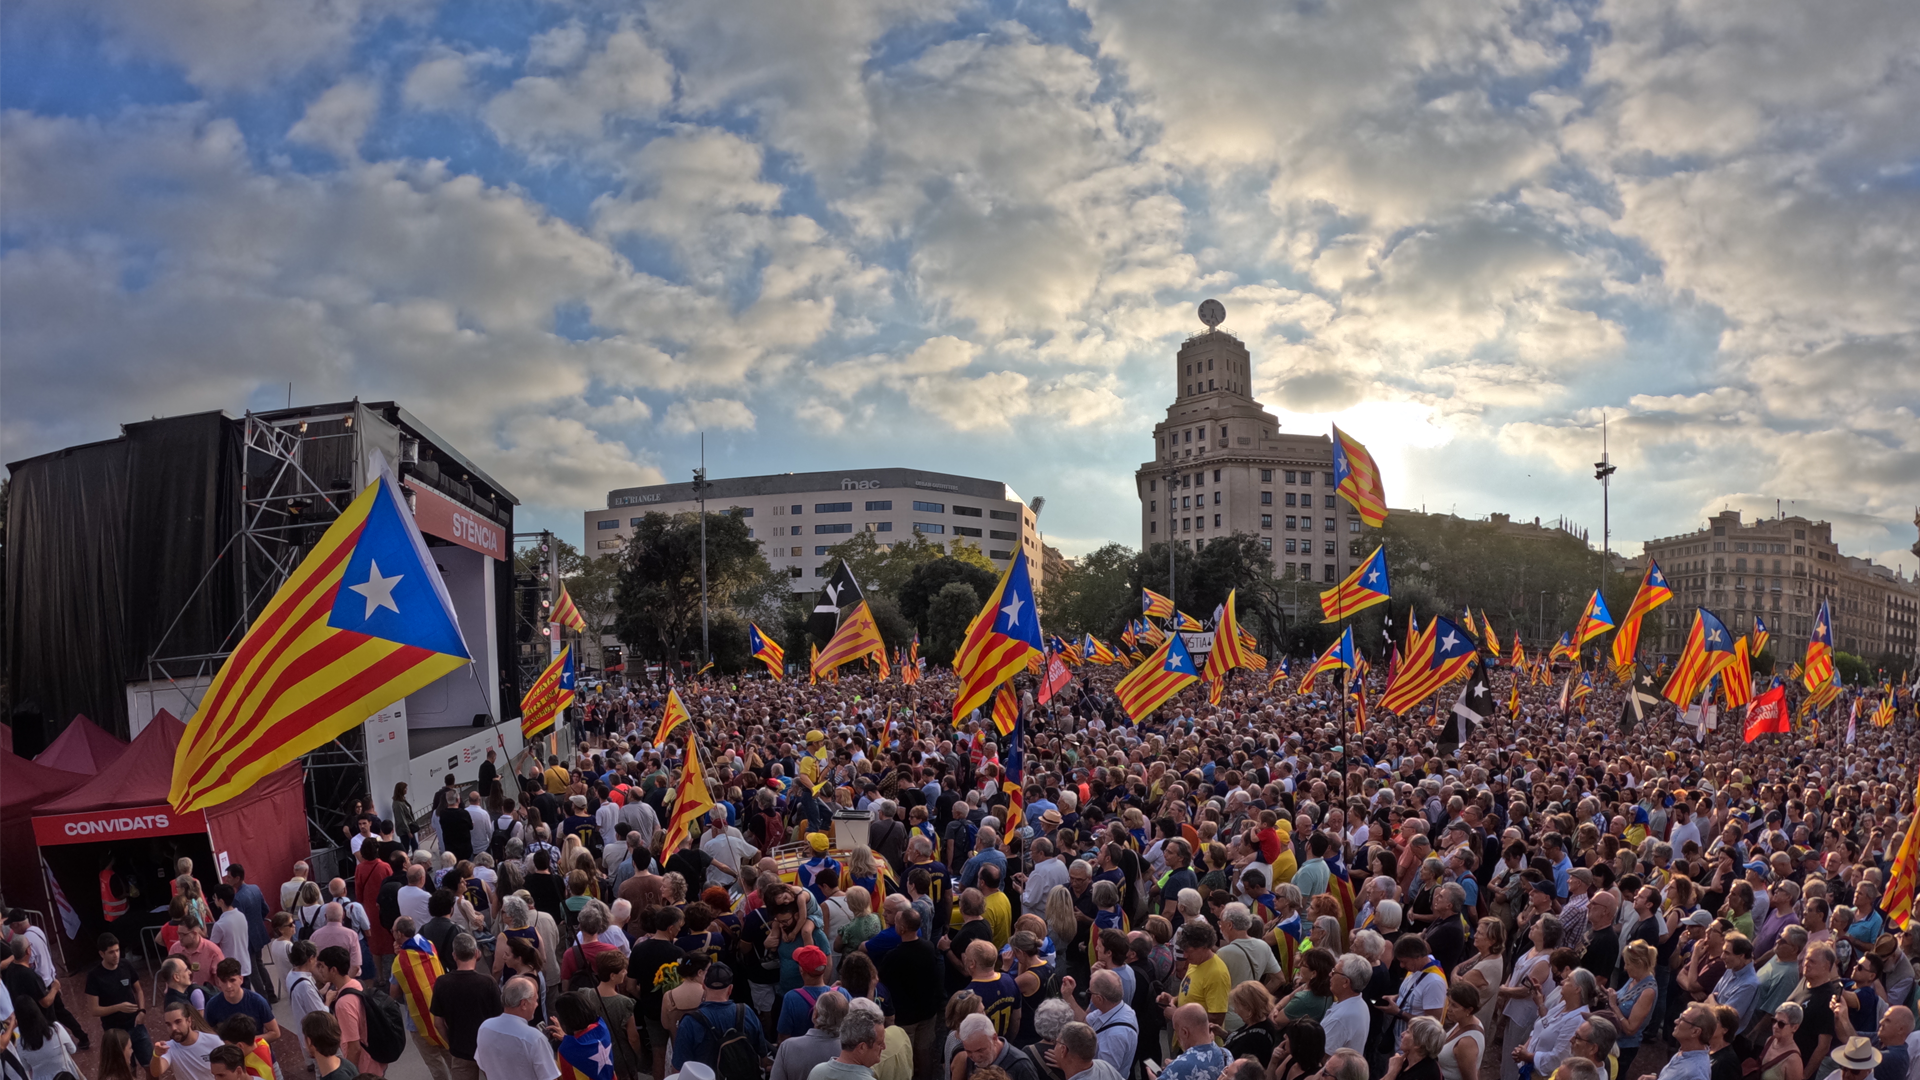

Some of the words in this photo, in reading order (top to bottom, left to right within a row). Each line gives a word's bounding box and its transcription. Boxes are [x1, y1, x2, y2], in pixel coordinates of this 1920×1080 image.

[841, 478, 880, 490] fnac
[615, 497, 624, 506] EL
[623, 493, 662, 505] TRIANGLE
[452, 512, 498, 553] STÈNCIA
[64, 814, 169, 836] CONVIDATS
[990, 1005, 1012, 1037] 11
